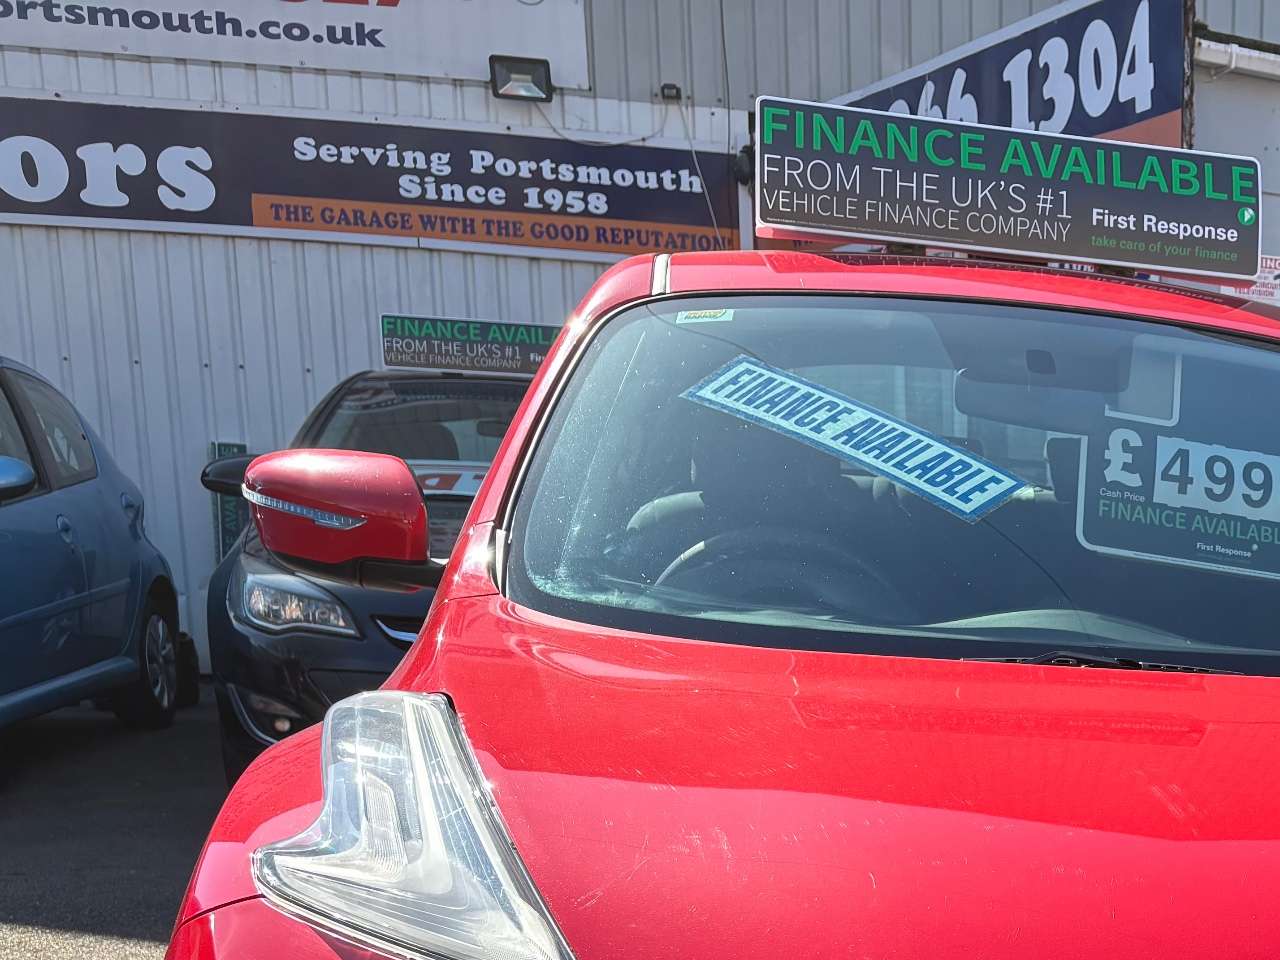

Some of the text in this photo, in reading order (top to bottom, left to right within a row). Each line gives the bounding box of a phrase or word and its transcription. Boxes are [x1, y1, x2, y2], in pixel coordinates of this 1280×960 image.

[1002, 0, 1154, 133] 1304
[0, 135, 216, 212] ors
[293, 137, 703, 194] Serving Portsmouth
[763, 106, 1257, 204] FINANCE AVAILABLE
[399, 174, 608, 215] Since 1958
[764, 154, 1072, 219] FROM THE UK'S #1
[270, 203, 314, 224] THE
[320, 207, 413, 230] GARAGE
[418, 214, 476, 235] WITH
[482, 218, 524, 239] THE
[530, 222, 589, 243] GOOD
[763, 188, 857, 219] VEHICLE
[866, 200, 959, 230] FINANCE
[966, 212, 1072, 243] COMPANY
[1092, 208, 1238, 242] First Response
[1091, 235, 1238, 262] take care of your finance
[383, 317, 481, 340] FINANCE
[384, 337, 427, 353] FROM
[432, 340, 463, 355] THE
[505, 345, 521, 360] #1
[385, 352, 521, 369] VEHICLE FINANCE COMPANY
[710, 368, 1000, 504] FINANCE AVAILABLE
[1099, 499, 1187, 529] FINANCE
[1100, 488, 1145, 502] Cash Price
[1196, 542, 1213, 552] First
[1215, 545, 1252, 558] Response
